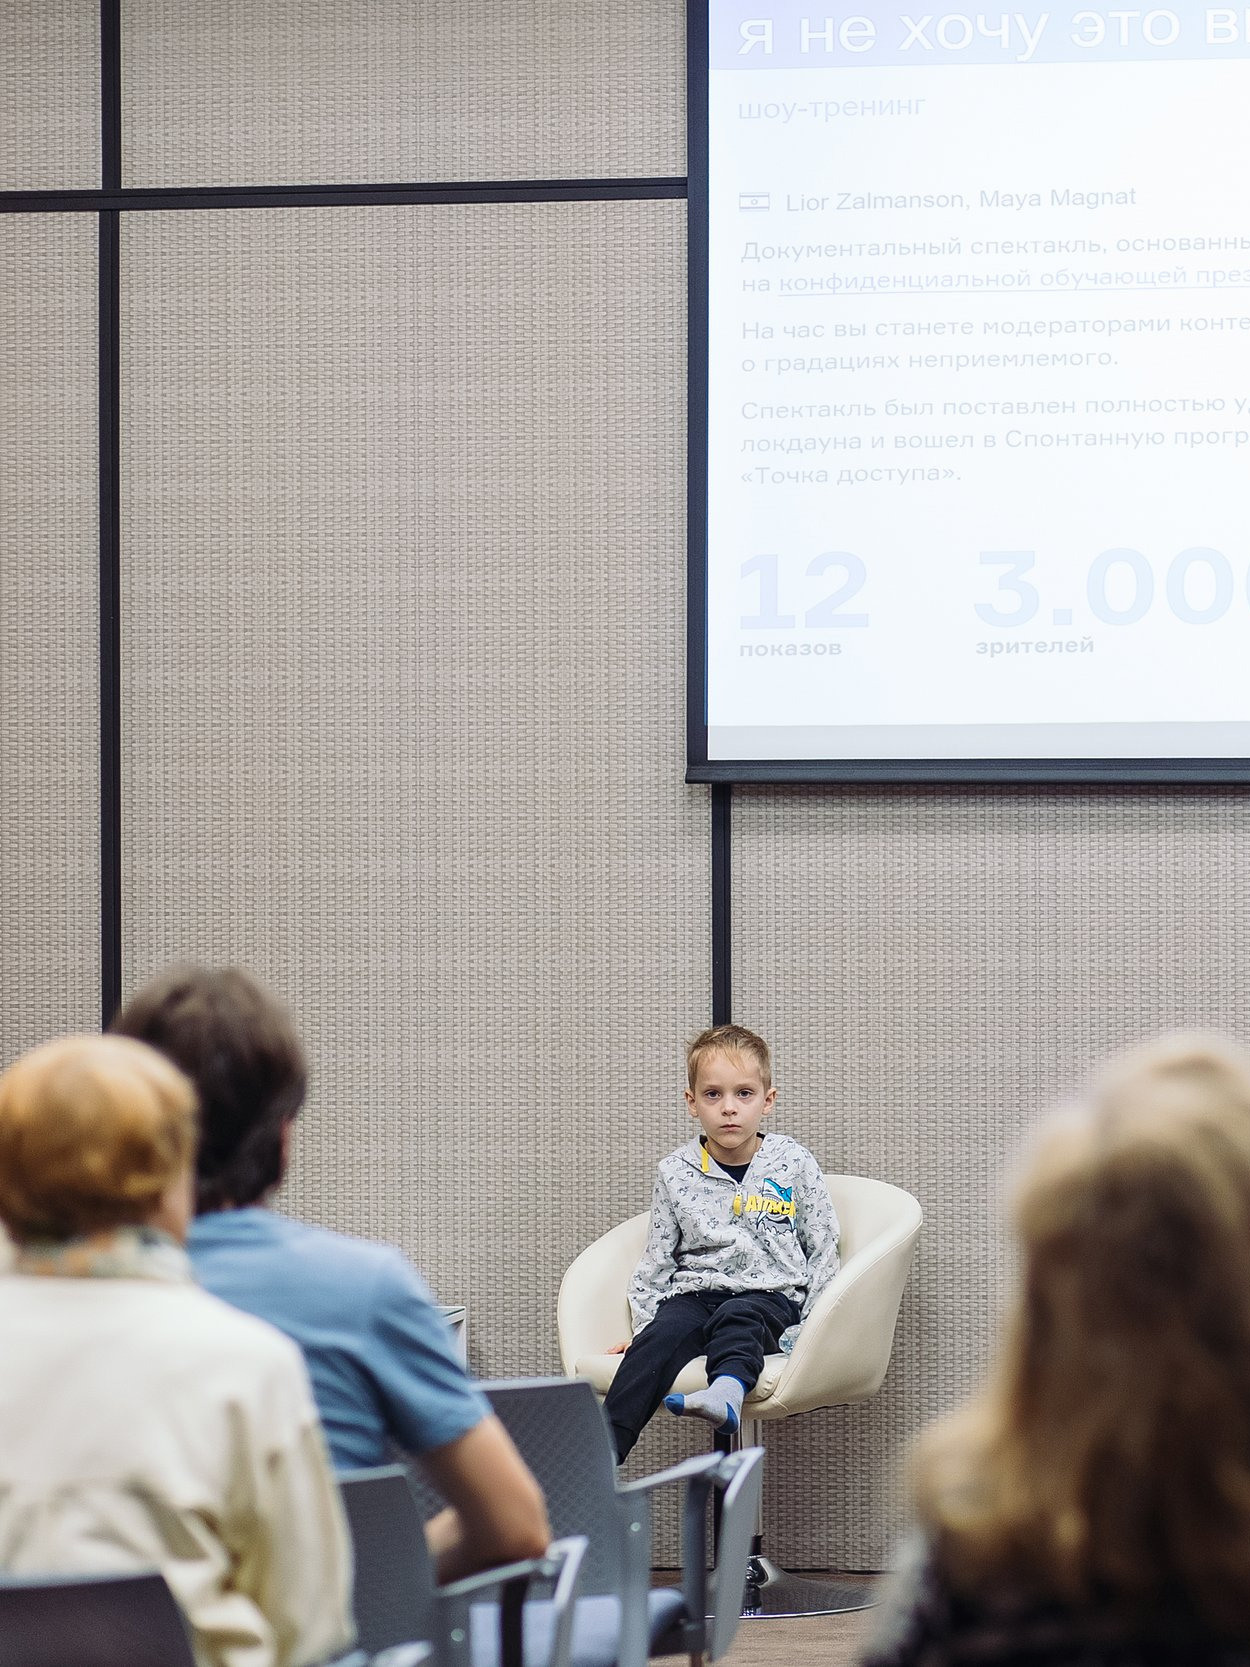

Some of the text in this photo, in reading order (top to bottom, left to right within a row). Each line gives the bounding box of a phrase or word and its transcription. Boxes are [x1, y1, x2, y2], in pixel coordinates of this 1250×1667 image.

[736, 18, 773, 55] я
[800, 15, 877, 53] не
[899, 11, 1049, 62] хочу
[1071, 9, 1181, 47] это
[738, 98, 926, 122] шоу-тренинг
[786, 187, 1136, 212] Lior Zalmanson, Maya Magnat
[741, 237, 962, 263] Документальный
[970, 238, 1108, 259] спектакль,
[742, 277, 771, 292] на
[780, 268, 1031, 294] конфиденциальной
[1040, 266, 1187, 291] обучающей
[741, 322, 774, 339] На
[783, 323, 825, 339] час
[834, 322, 866, 338] вы
[875, 320, 974, 337] станете
[983, 316, 1171, 338] модераторами
[741, 351, 1119, 375] о градациях неприемлемого.
[741, 401, 876, 421] Спектакль
[884, 399, 934, 416] был
[943, 399, 1076, 416] поставлен
[1085, 397, 1226, 414] полностью
[740, 435, 862, 455] локдауна
[870, 434, 885, 449] и
[893, 433, 974, 449] вошел
[984, 433, 997, 449] в
[1005, 428, 1165, 450] Спонтанную
[740, 465, 962, 486] «Точка доступа».
[740, 550, 870, 630] 12
[739, 641, 843, 658] показов
[975, 636, 1095, 657] зрителей
